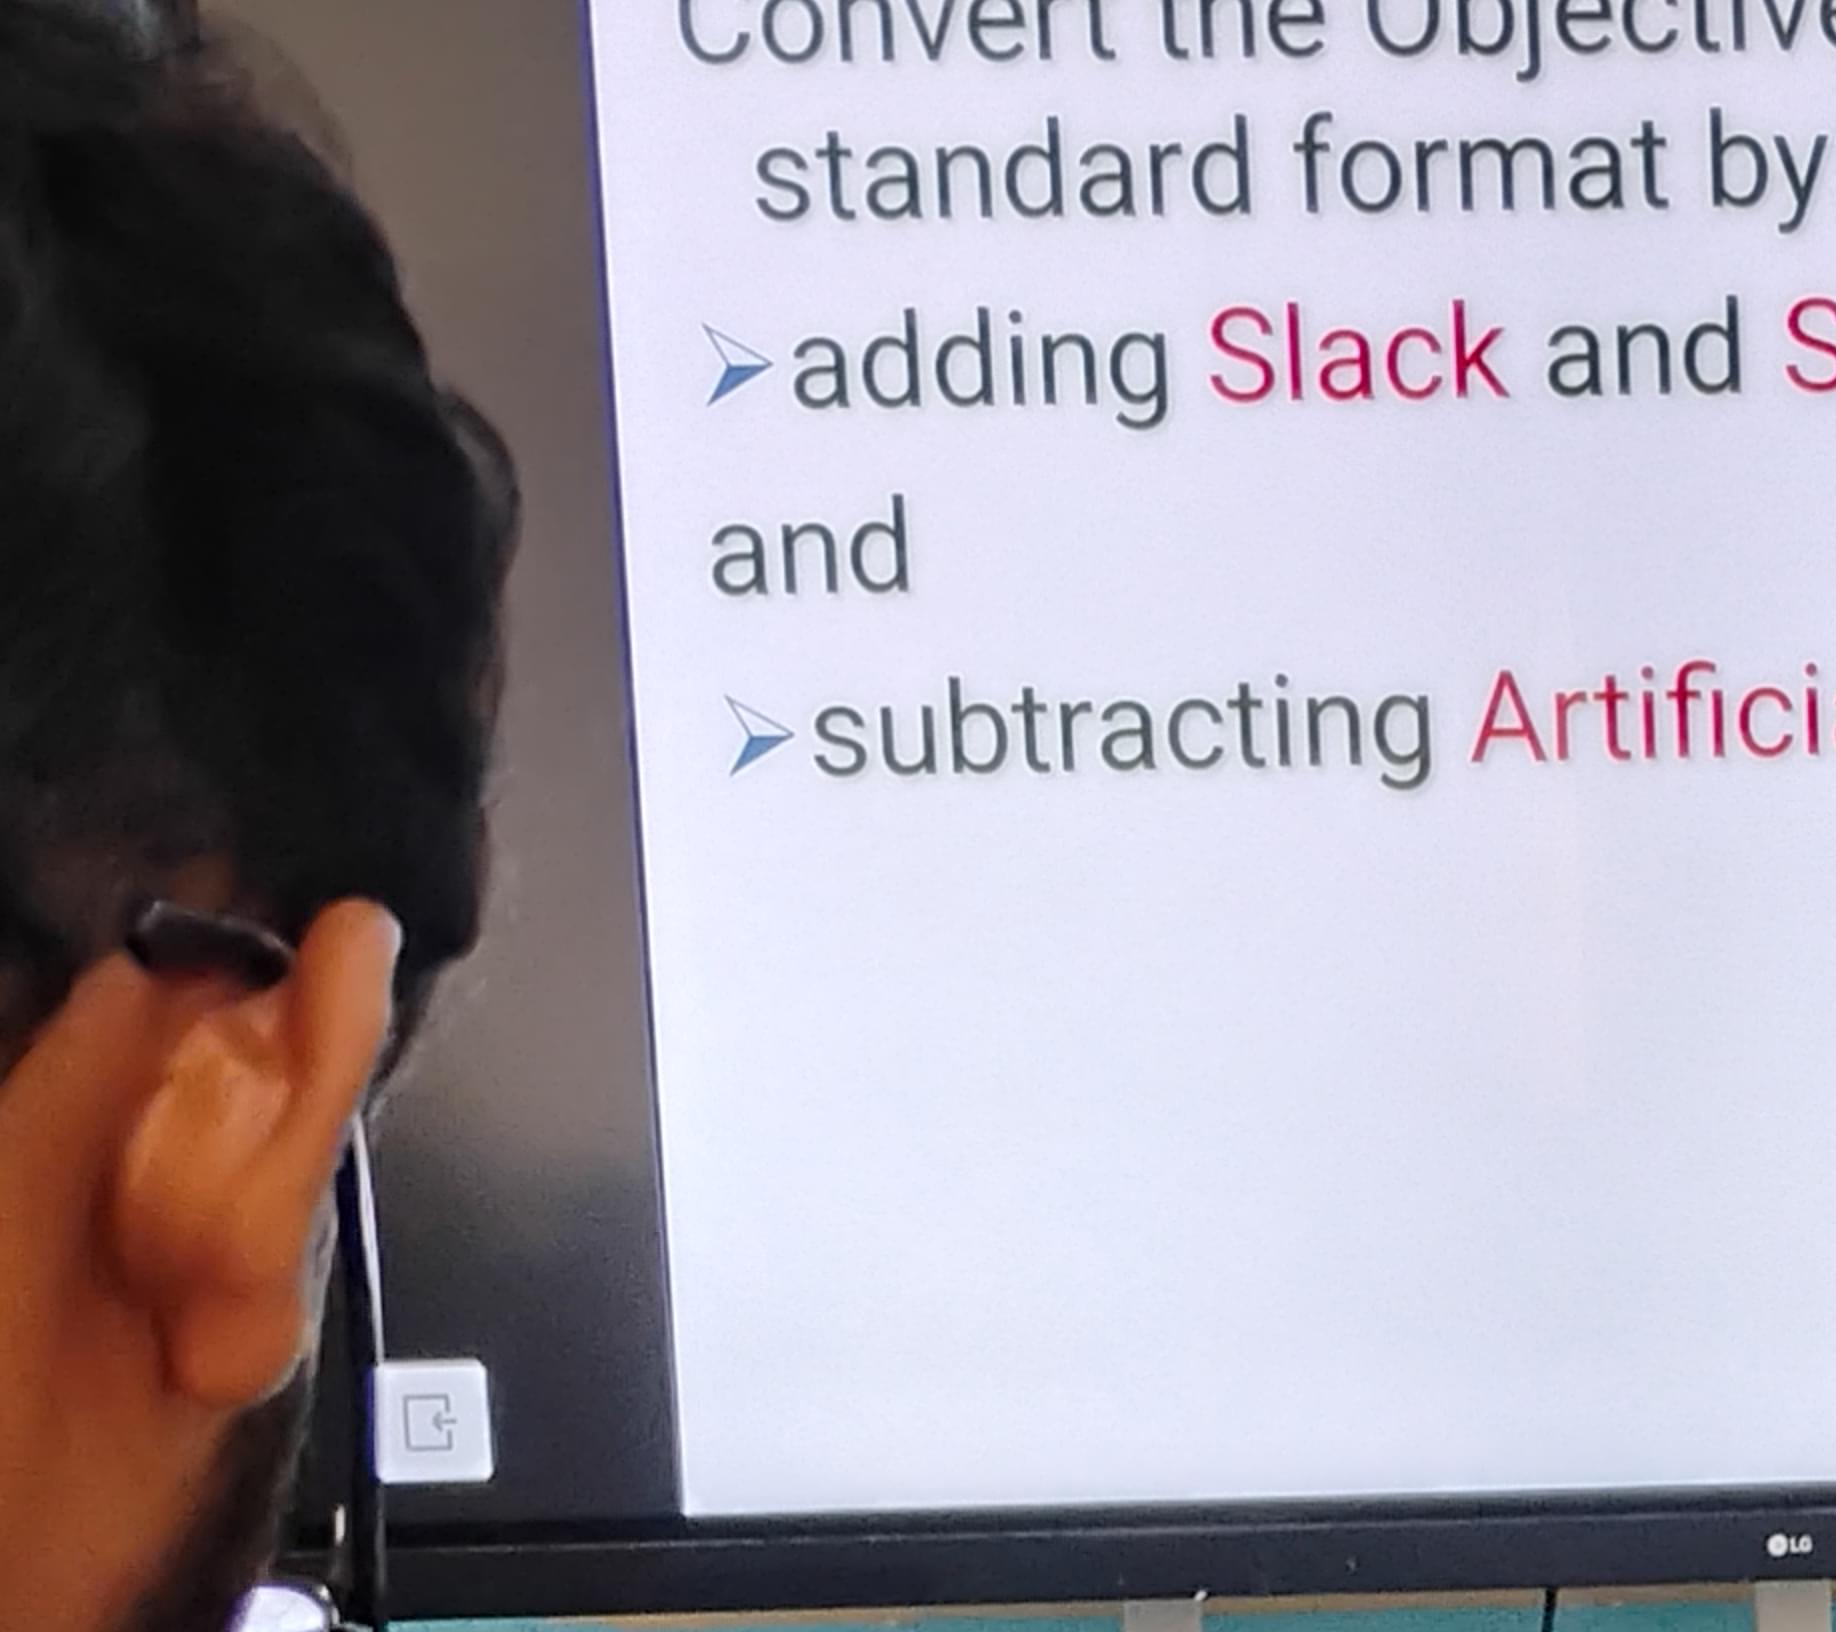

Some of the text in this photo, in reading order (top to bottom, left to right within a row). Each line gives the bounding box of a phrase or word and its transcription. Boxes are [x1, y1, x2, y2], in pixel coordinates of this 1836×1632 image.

[754, 112, 1253, 222] standard
[1292, 110, 1670, 215] format
[791, 306, 1170, 430] adding
[1209, 297, 1511, 404] Slack
[1546, 293, 1742, 398] and
[710, 492, 911, 597] and
[812, 674, 1433, 791] subtracting
